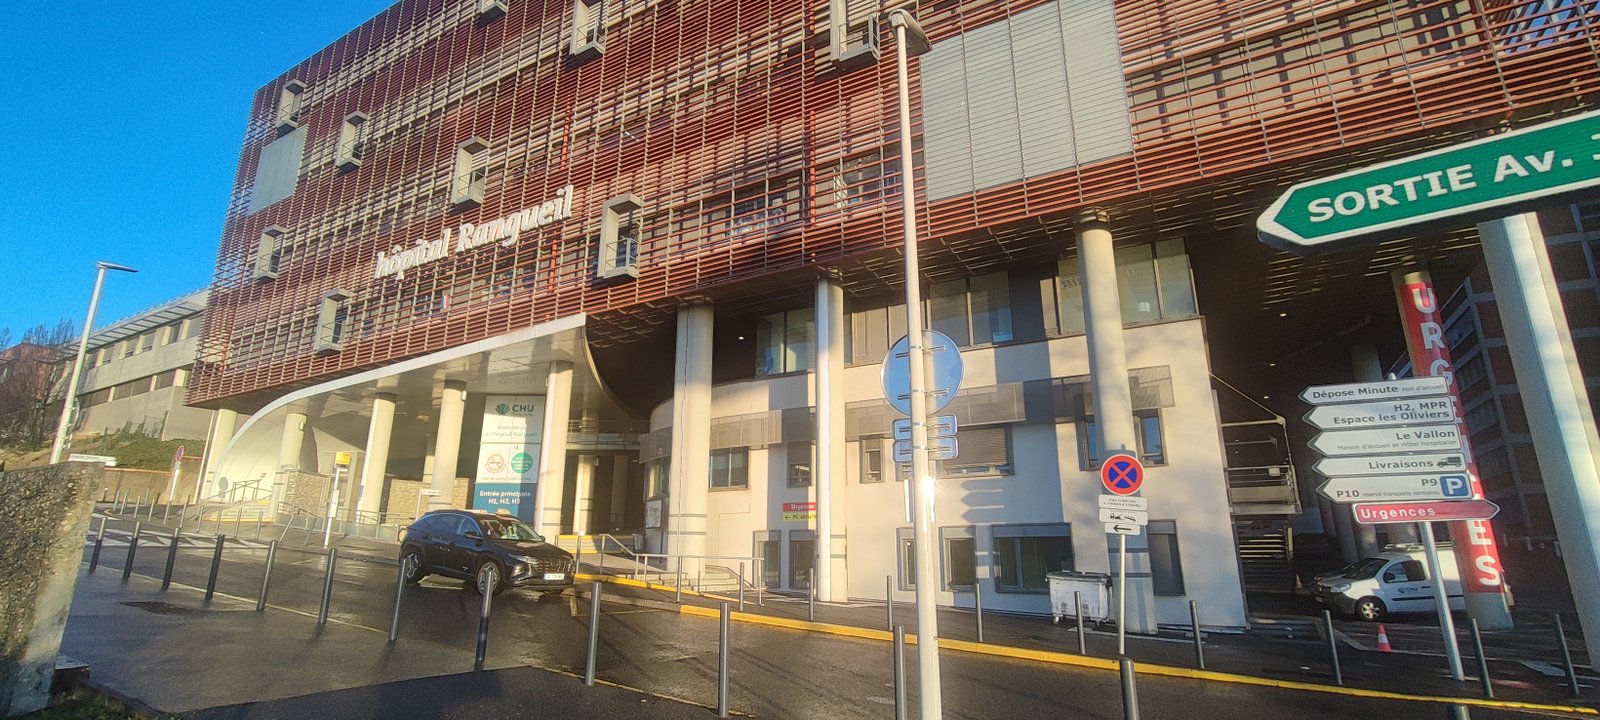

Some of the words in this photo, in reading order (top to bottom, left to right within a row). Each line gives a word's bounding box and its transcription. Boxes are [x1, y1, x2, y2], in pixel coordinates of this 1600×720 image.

[1307, 163, 1478, 223] SORTIE
[1494, 150, 1574, 183] Av.
[374, 228, 452, 280] hôpital
[456, 184, 574, 253] Rangueil
[1312, 389, 1354, 399] Dépose
[1358, 385, 1398, 395] Minute
[512, 404, 535, 412] CHU
[1394, 403, 1415, 413] H2,
[1419, 401, 1447, 410] MPR
[1333, 416, 1376, 425] Espace
[1379, 413, 1397, 422] les
[1400, 410, 1450, 420] Oliviers
[1396, 432, 1411, 440] Le
[1413, 430, 1455, 439] Vallon
[1412, 288, 1500, 586] URGES
[1421, 439, 1457, 447] hospitalier
[1369, 460, 1433, 469] Livraisons
[1421, 478, 1437, 487] P9
[1445, 478, 1463, 495] P
[500, 490, 531, 498] principale
[1336, 490, 1360, 498] P10
[1361, 506, 1436, 520] Urgences
